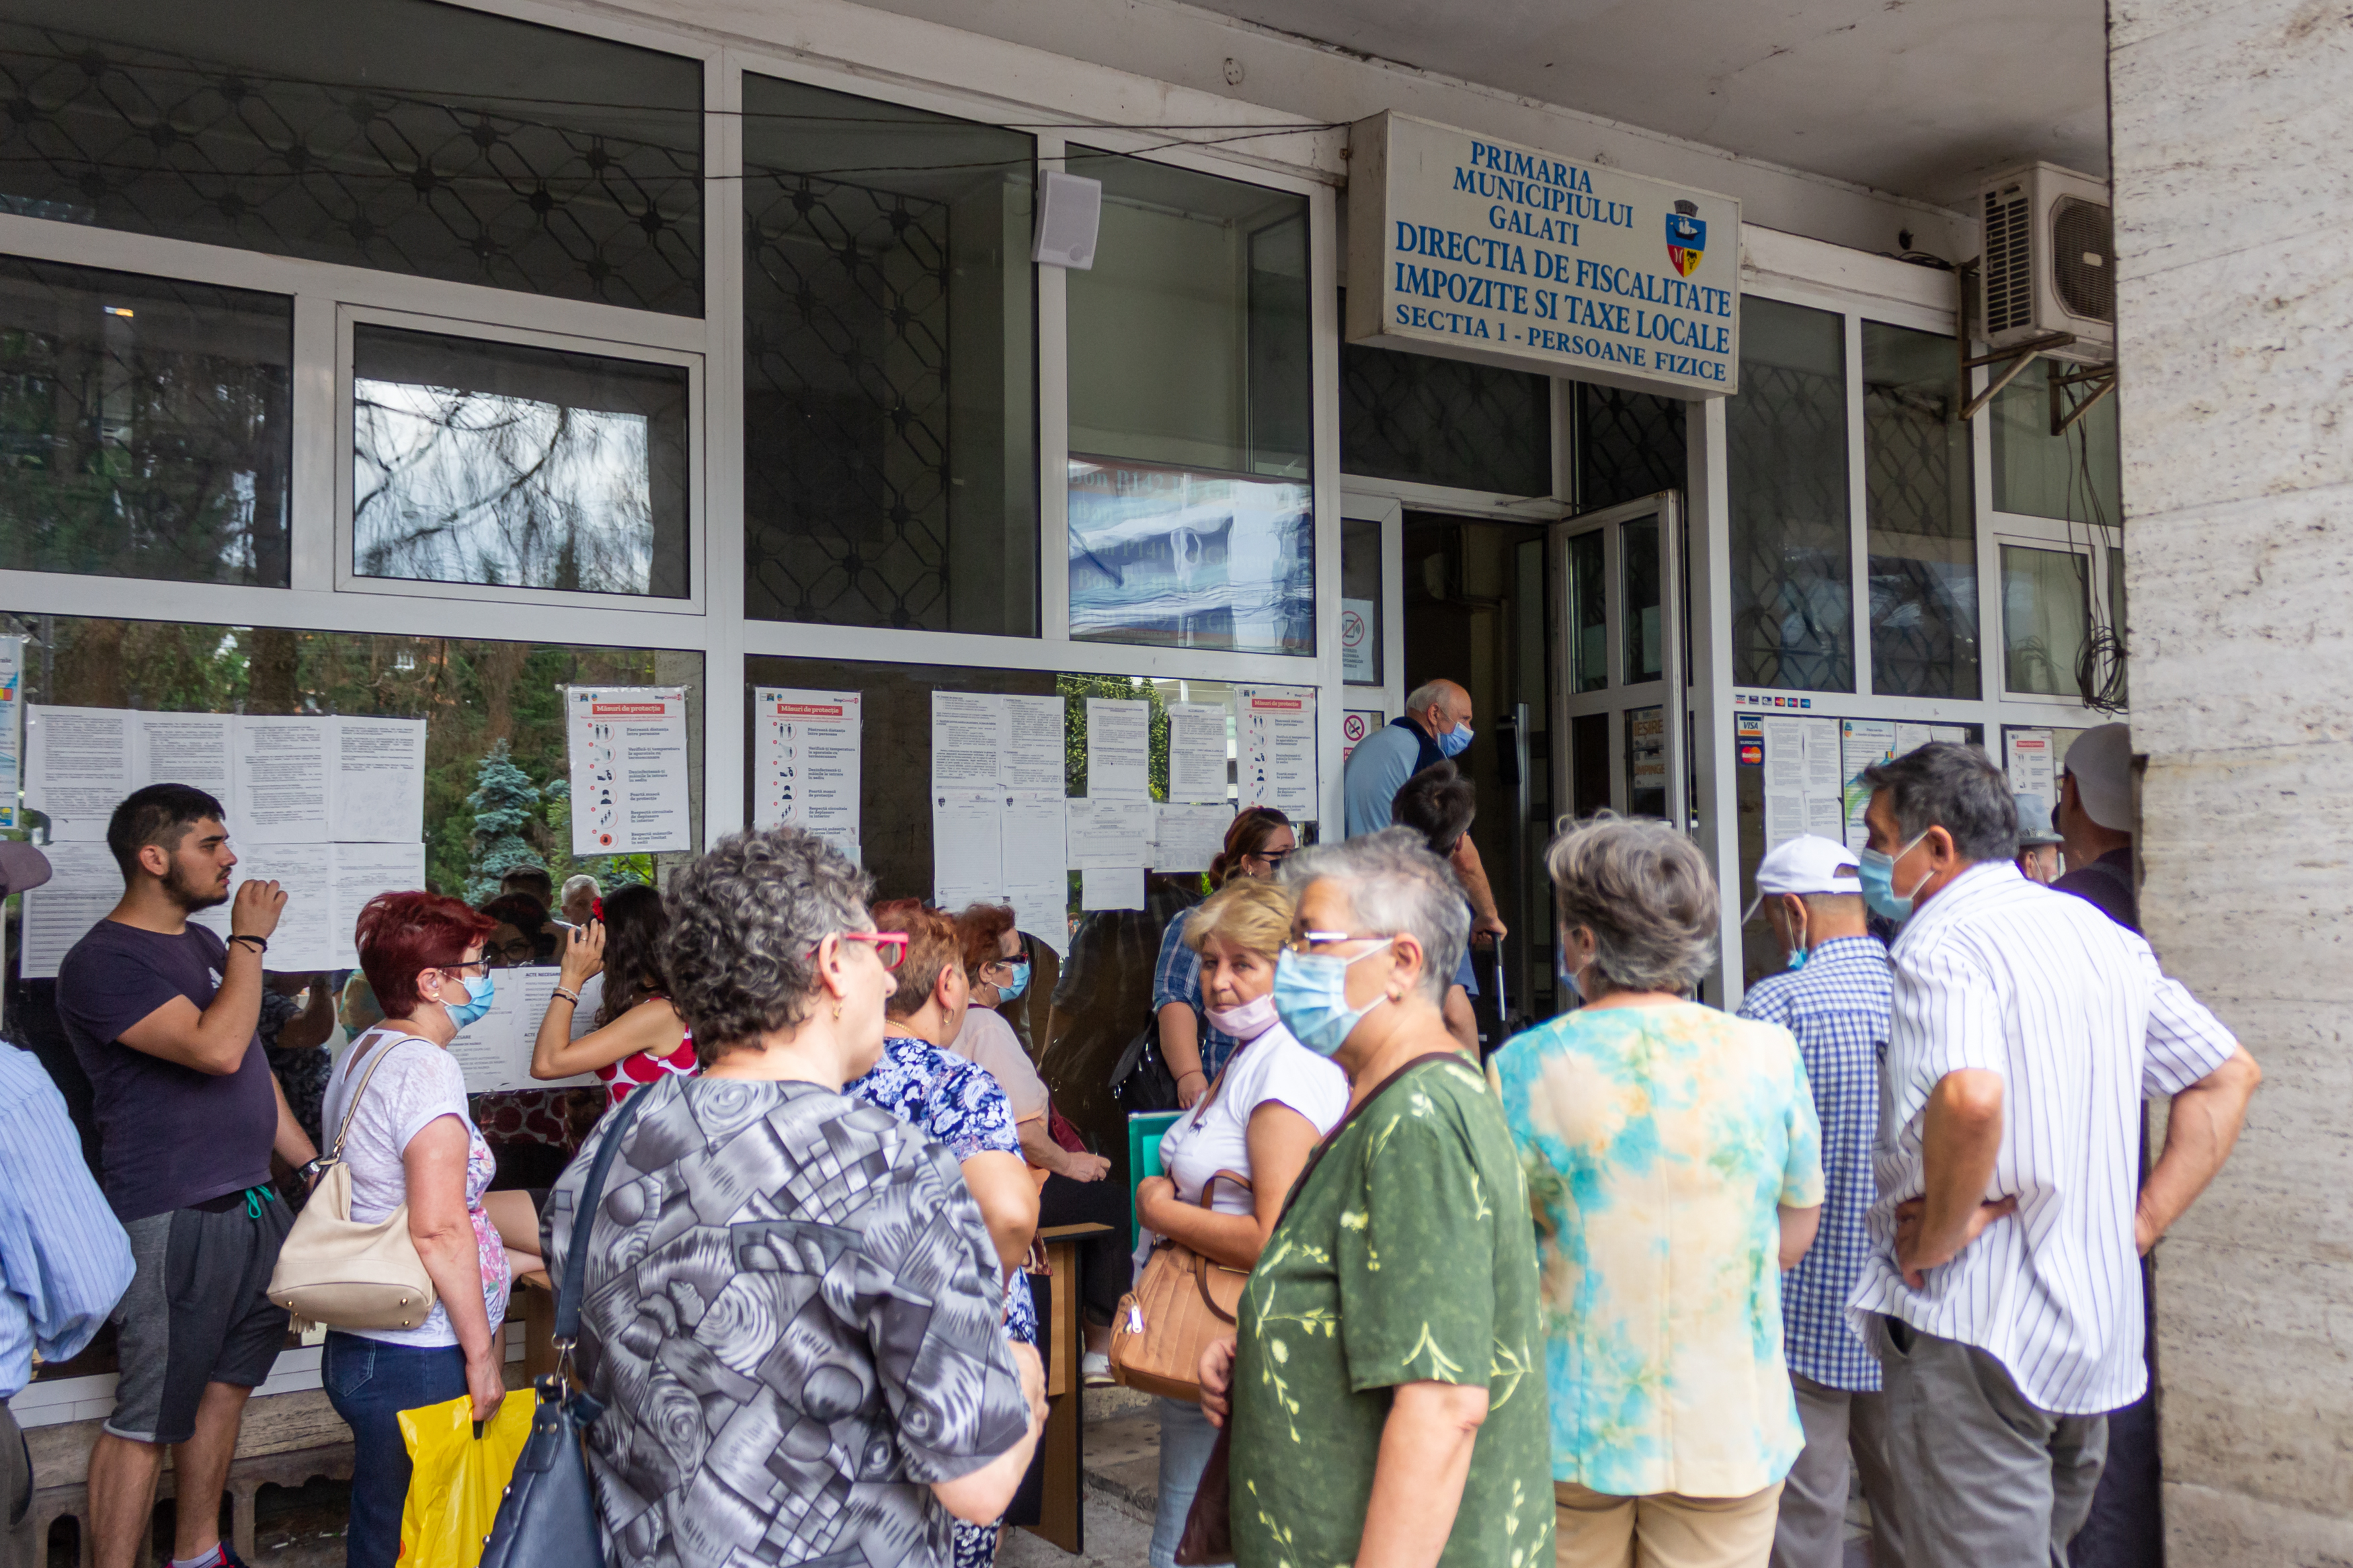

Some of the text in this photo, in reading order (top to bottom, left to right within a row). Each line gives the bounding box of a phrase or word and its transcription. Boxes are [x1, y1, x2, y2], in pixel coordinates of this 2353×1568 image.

[1453, 167, 1634, 229] MUNICIPIULUI
[1471, 140, 1593, 194] PRIMARIA
[1489, 205, 1580, 247] GALATI
[1396, 220, 1731, 318] DIRECTIA DE FISCALITATE
[1395, 263, 1730, 354] IMPOZITE SI TAXE LOCALE
[1396, 304, 1490, 339] SECTIA
[1498, 323, 1507, 342] 1
[1527, 327, 1646, 368] PERSOANE
[1654, 351, 1726, 382] FIZICE
